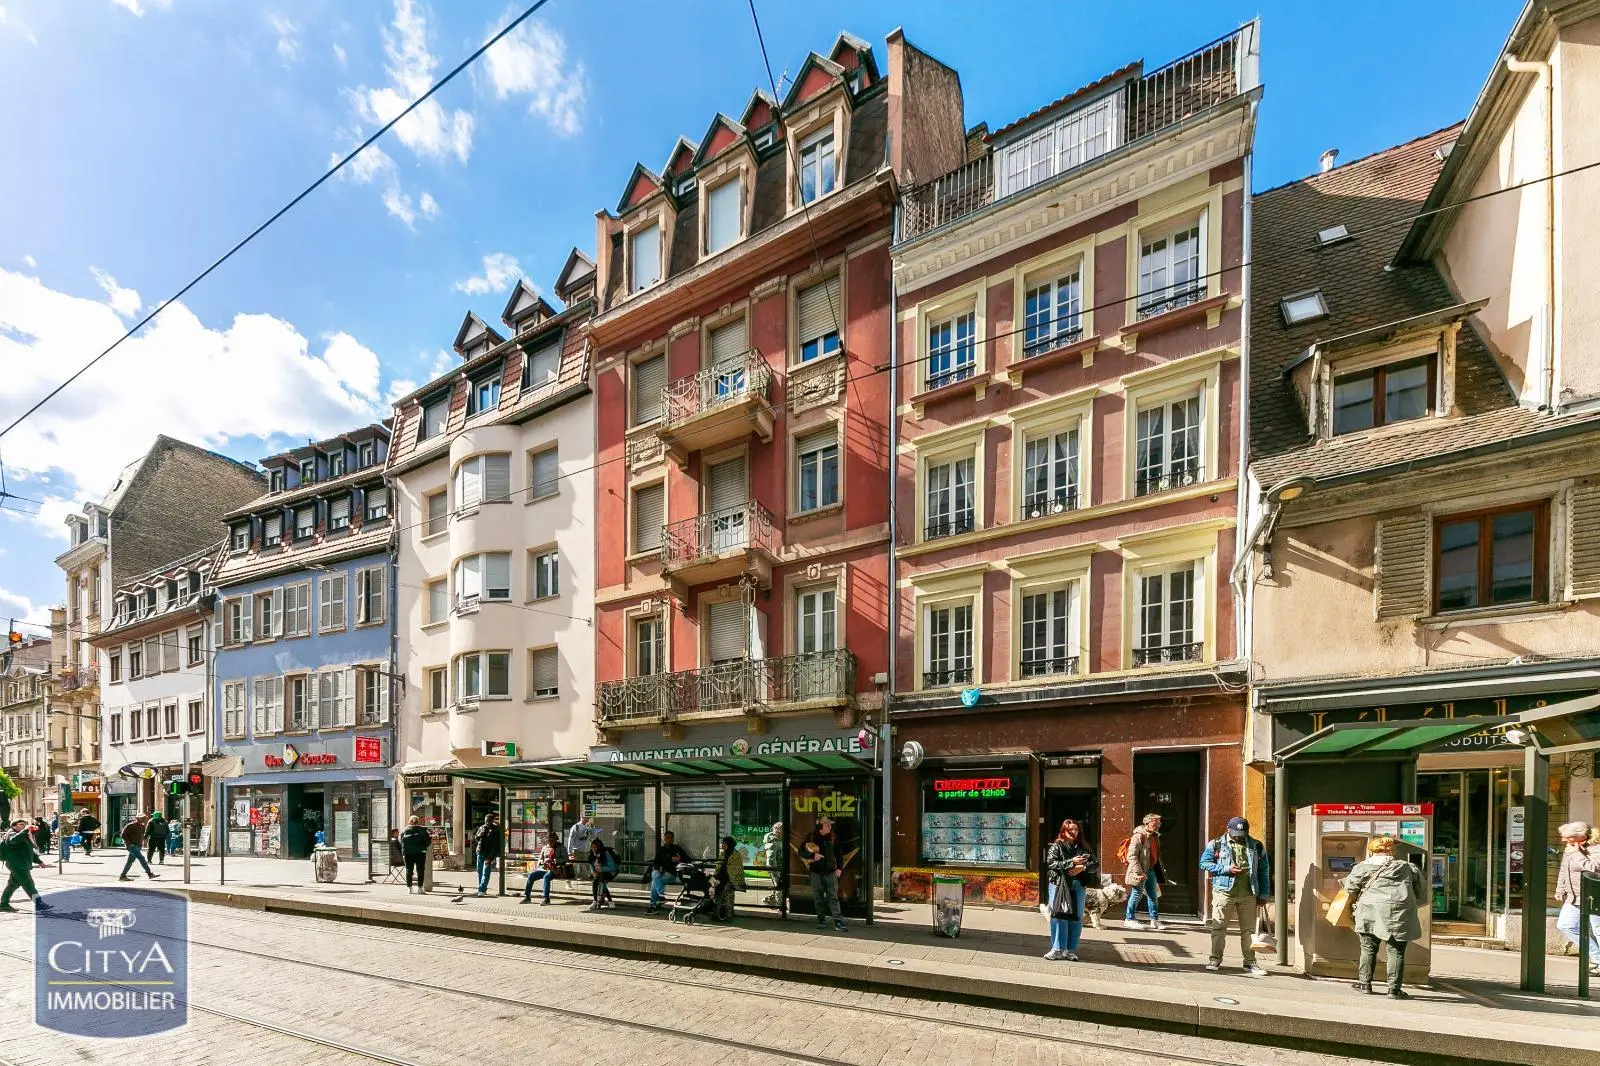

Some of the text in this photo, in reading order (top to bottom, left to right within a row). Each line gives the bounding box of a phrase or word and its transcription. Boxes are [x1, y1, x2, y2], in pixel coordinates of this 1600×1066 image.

[611, 736, 861, 761] ALIMENTATION GÉNÉRALE
[795, 791, 855, 812] undiz
[945, 790, 966, 799] partir
[968, 789, 979, 797] de
[982, 788, 1006, 797] 12h00
